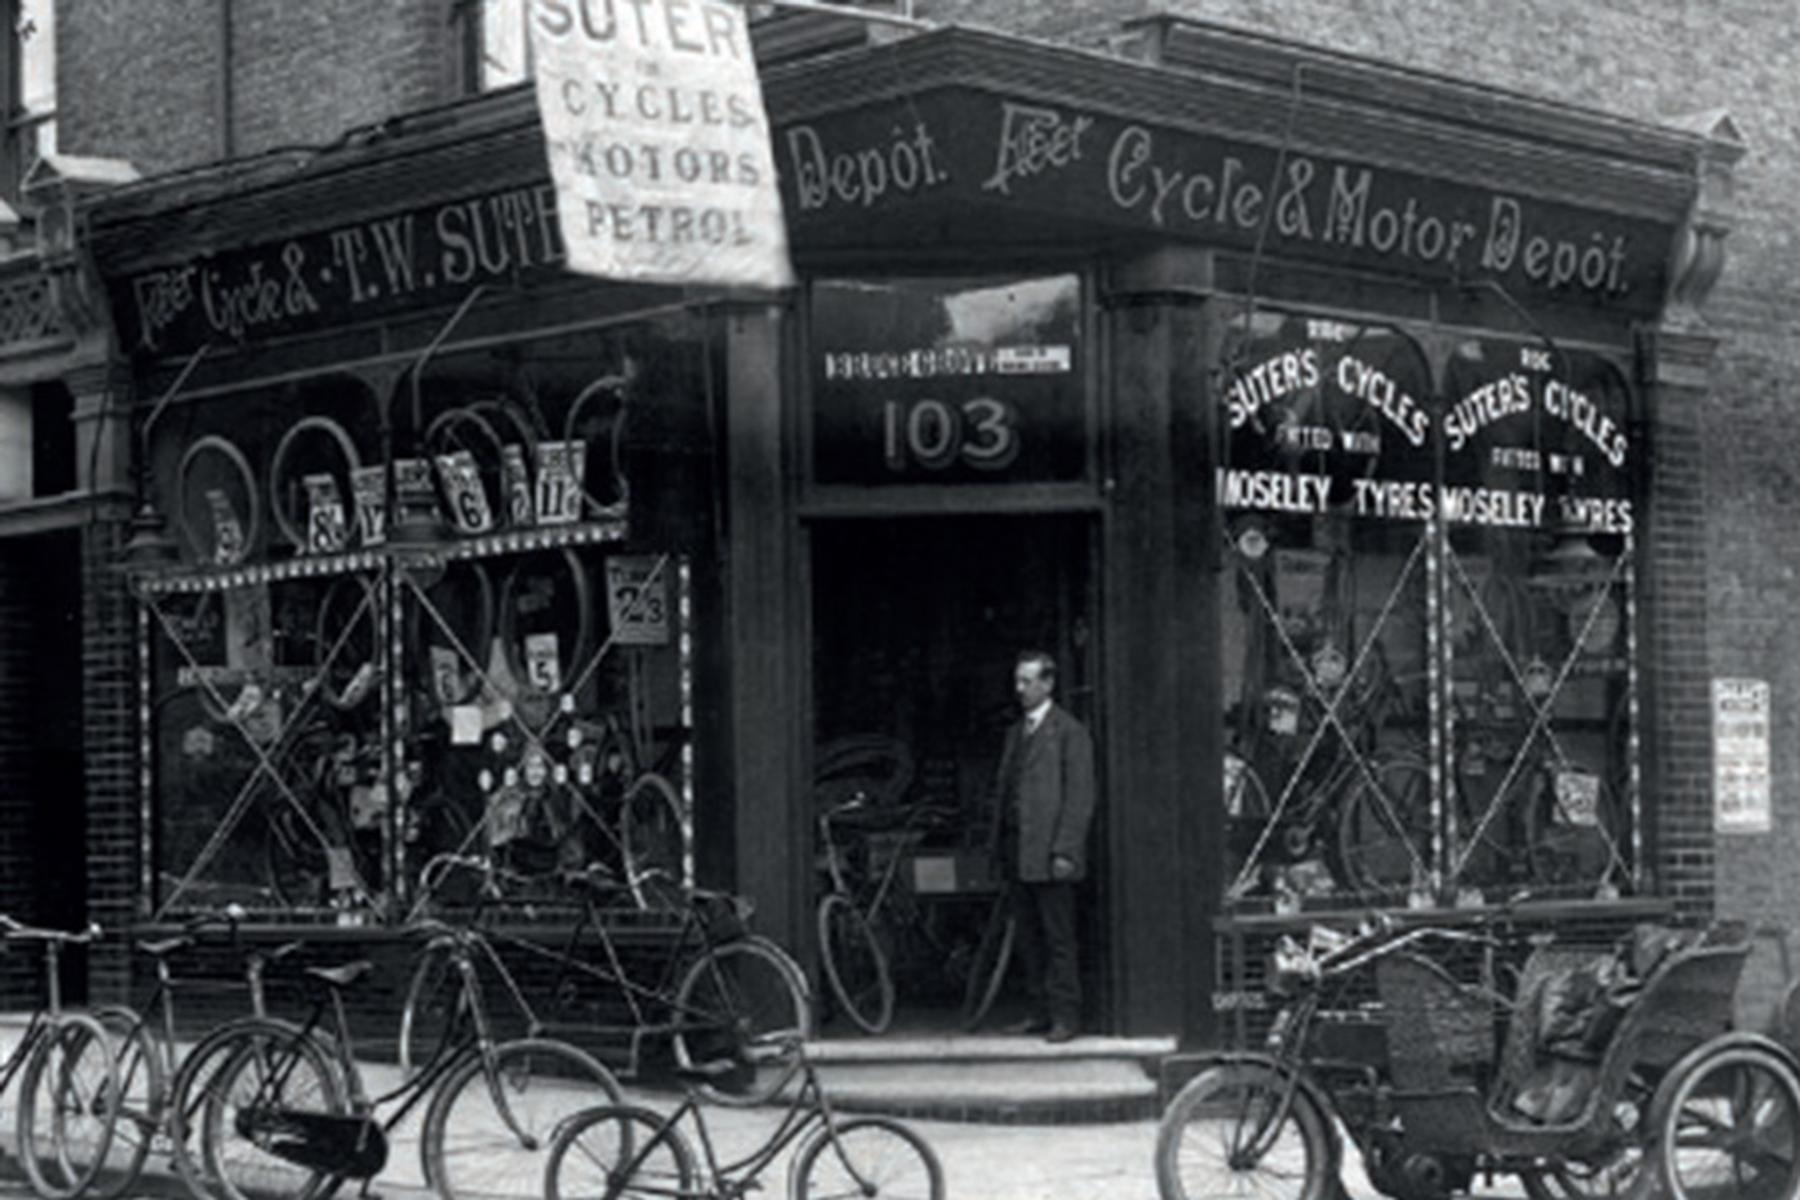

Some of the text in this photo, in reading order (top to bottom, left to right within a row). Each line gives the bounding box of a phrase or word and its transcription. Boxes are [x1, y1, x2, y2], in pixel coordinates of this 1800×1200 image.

[538, 0, 741, 57] SUTER
[561, 79, 756, 129] CYCLES
[572, 140, 760, 187] MOTORS
[585, 200, 755, 247] PETROL
[1108, 126, 1264, 228] Cycle
[1275, 158, 1314, 241] &
[1323, 164, 1475, 264] Motor
[281, 242, 319, 316] &
[435, 181, 569, 284] SUTE
[1223, 347, 1430, 447] SUTER'S CYCLES
[1442, 371, 1629, 466] SUTER'S CYCLES
[885, 397, 1016, 464] 103
[1214, 466, 1435, 520] MOSELEY TYRES
[1439, 484, 1545, 528] MOSELEY
